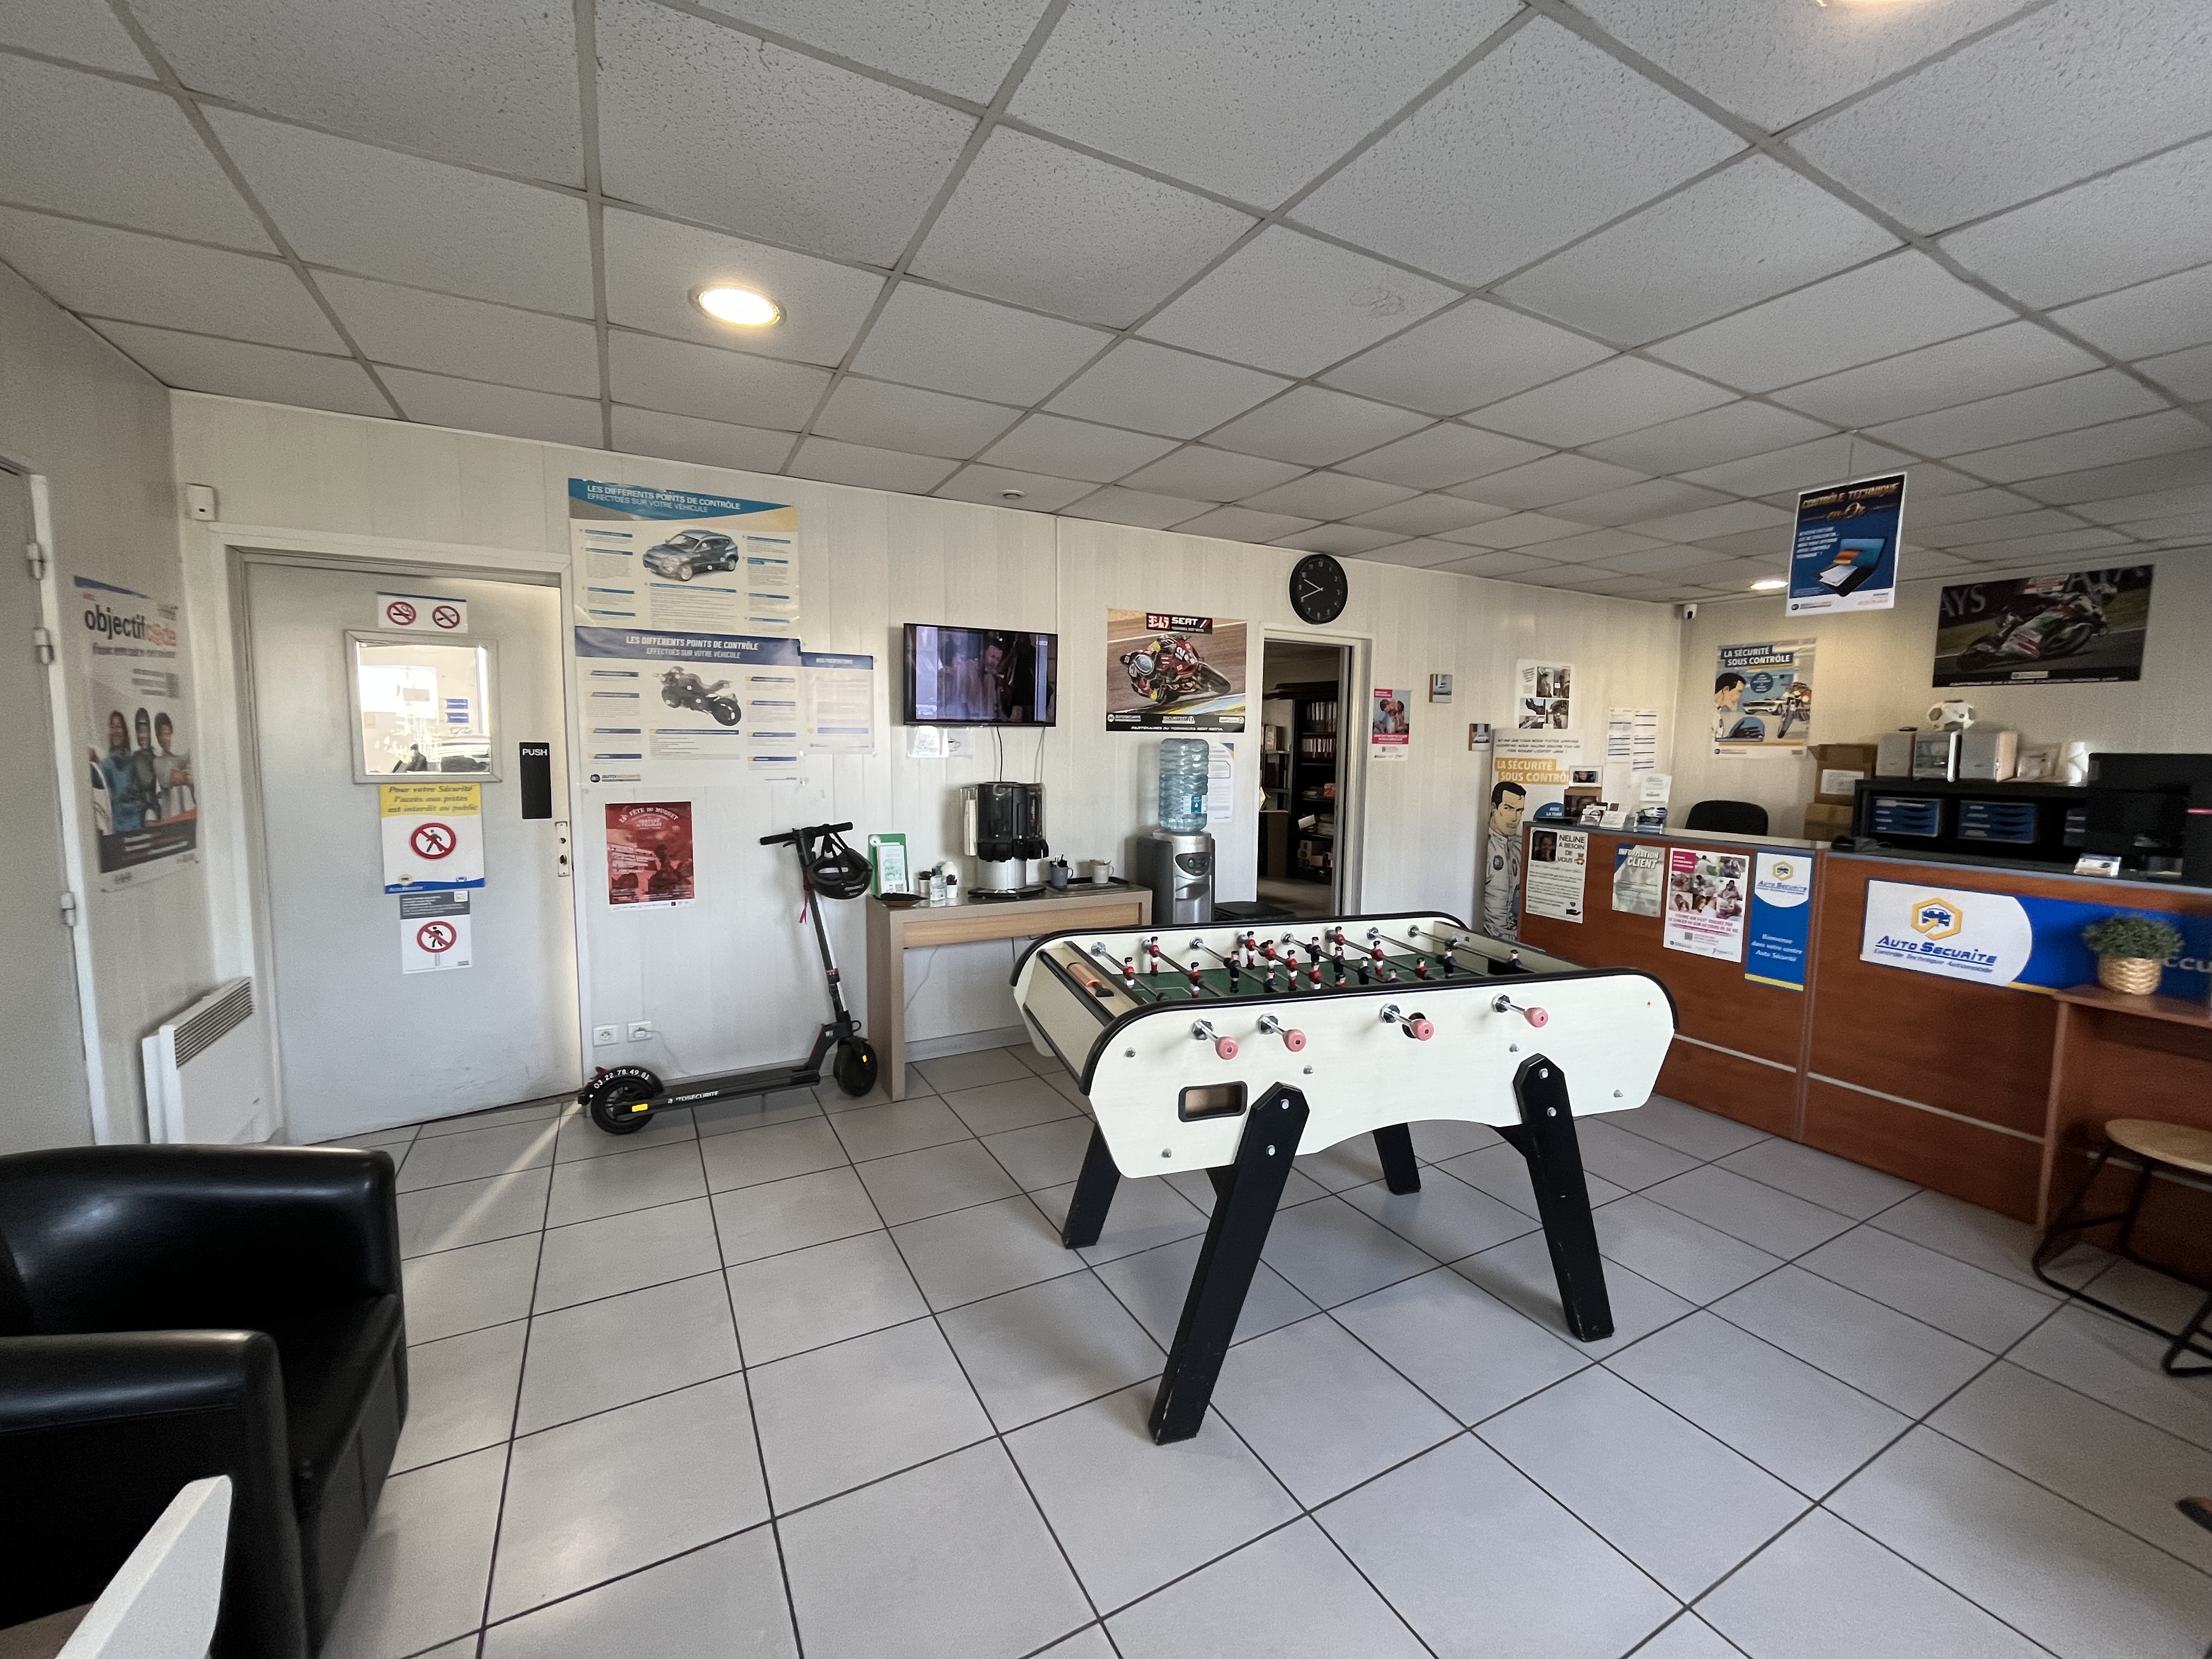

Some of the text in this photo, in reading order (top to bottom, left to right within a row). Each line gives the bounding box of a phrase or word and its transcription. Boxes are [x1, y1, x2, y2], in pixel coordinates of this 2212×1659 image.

[588, 485, 603, 493] LES
[656, 493, 685, 504] POINTS
[699, 499, 741, 510] CONTRÔLE
[631, 498, 647, 506] SUR
[626, 636, 639, 644] LES
[641, 636, 685, 646] DIFFÉRENTS
[686, 639, 712, 648] POINTS
[724, 641, 759, 651] CONTRÔLE
[646, 647, 680, 656] EFFECTUÉS
[714, 651, 741, 659] VÉHICULE
[1734, 646, 1769, 657] SÉCURITÉ
[1727, 654, 1790, 666] SOUS CONTRÔLE
[1497, 758, 1553, 771] LA SÉCURITÉ
[1501, 772, 1523, 781] SOUS
[1559, 834, 1585, 844] NELINE
[1618, 848, 1660, 860] INFORMATION
[1627, 857, 1658, 869] CLIENT
[594, 1080, 603, 1089] 03
[605, 1073, 614, 1081] 22
